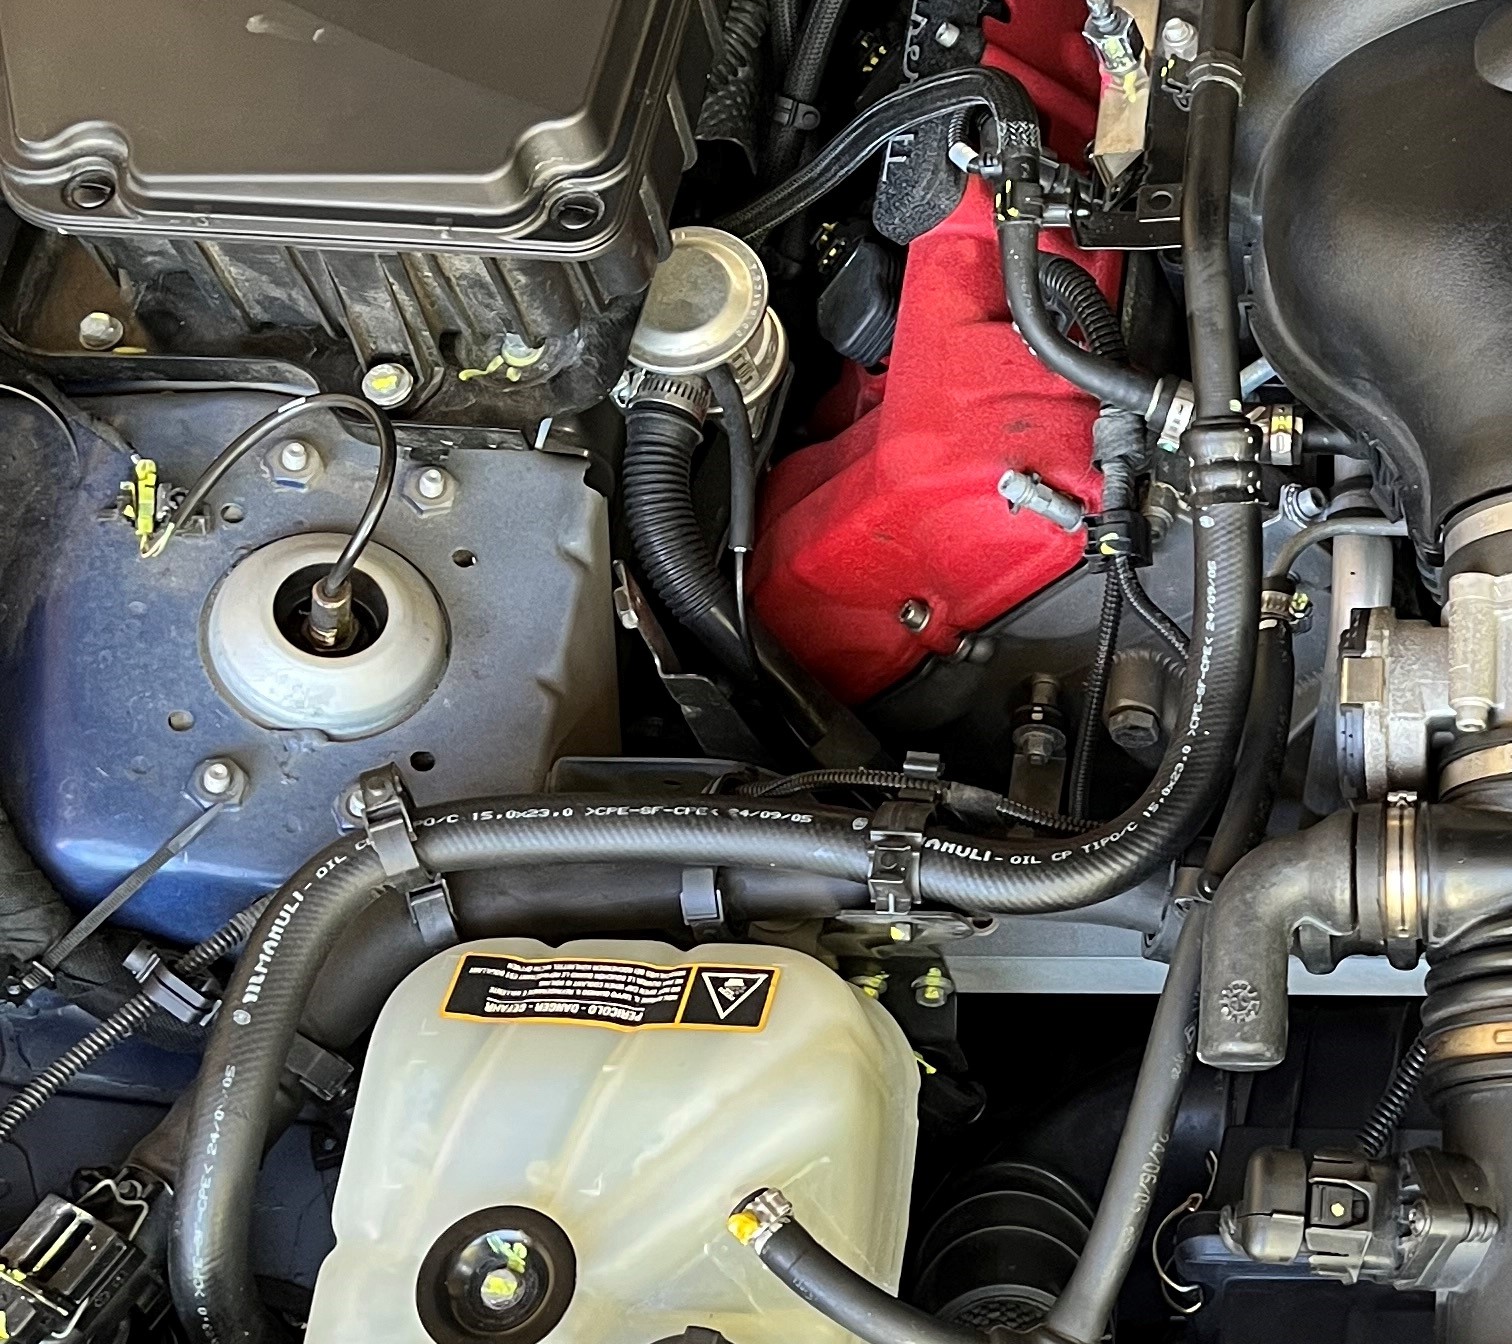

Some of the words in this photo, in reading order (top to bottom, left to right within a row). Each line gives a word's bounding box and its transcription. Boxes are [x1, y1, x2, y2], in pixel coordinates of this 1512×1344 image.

[1010, 855, 1042, 865] OIL
[1051, 849, 1073, 862] CP
[315, 856, 347, 879] OIL
[534, 1002, 580, 1014] DANGER
[587, 1004, 644, 1022] PERICOLO
